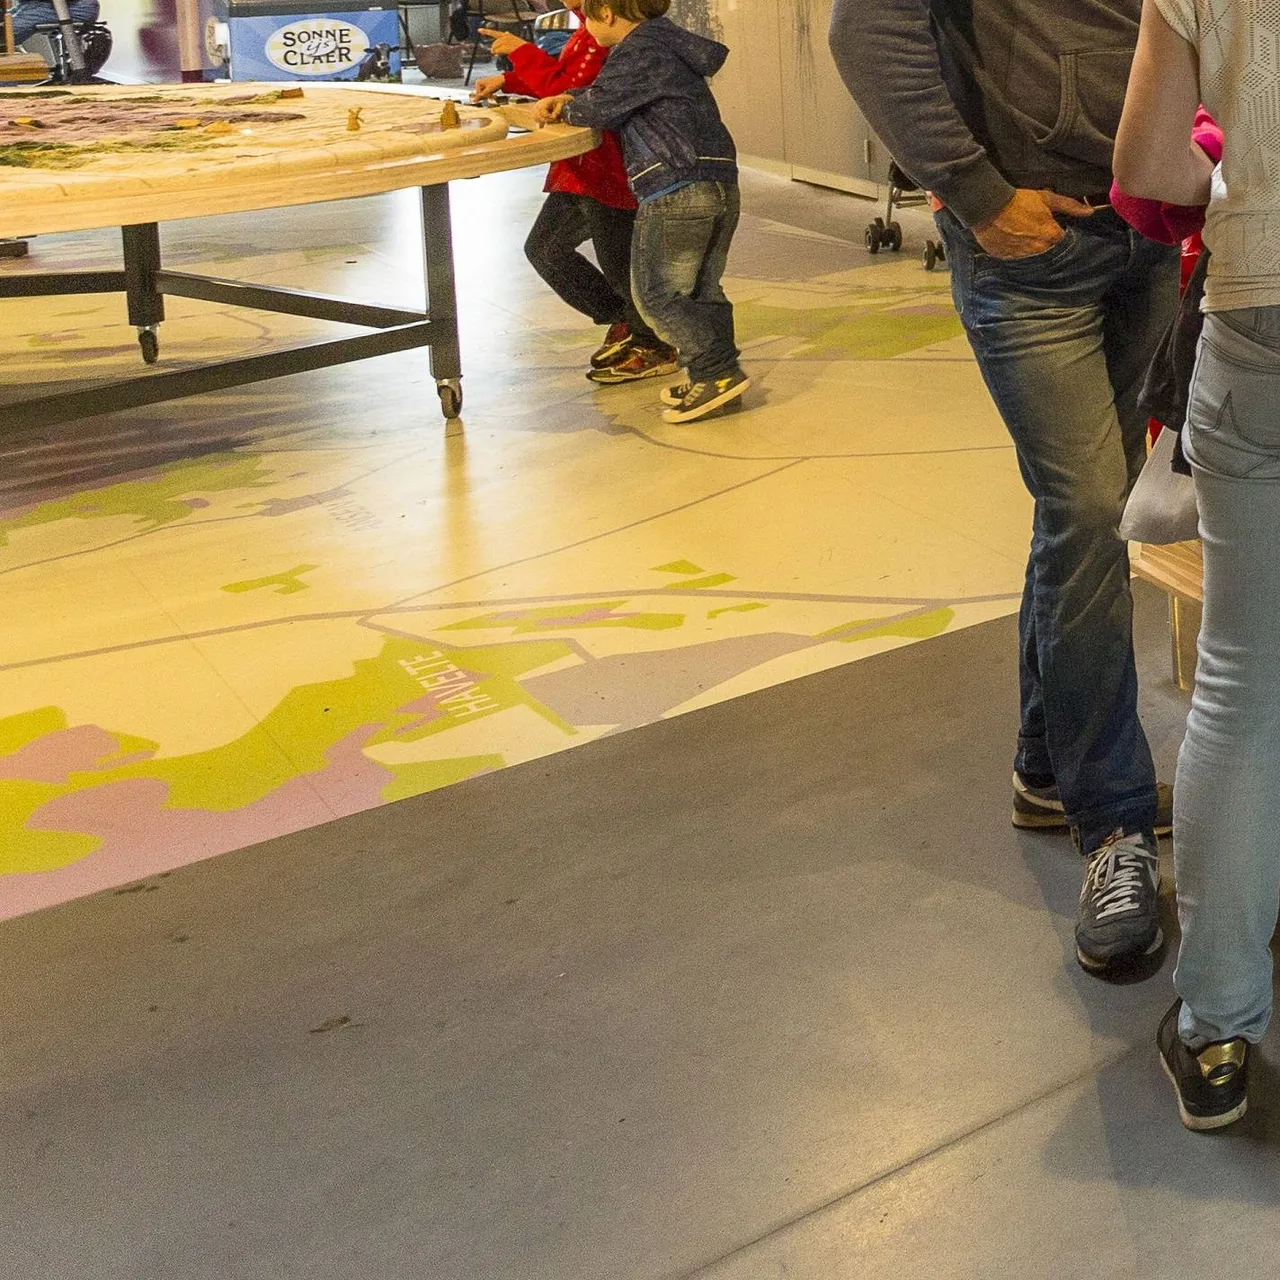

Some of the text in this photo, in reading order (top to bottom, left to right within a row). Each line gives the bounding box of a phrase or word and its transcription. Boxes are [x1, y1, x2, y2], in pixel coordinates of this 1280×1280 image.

[282, 28, 351, 47] SONNE
[283, 46, 353, 66] CLAER
[397, 650, 500, 719] HAVELTE
